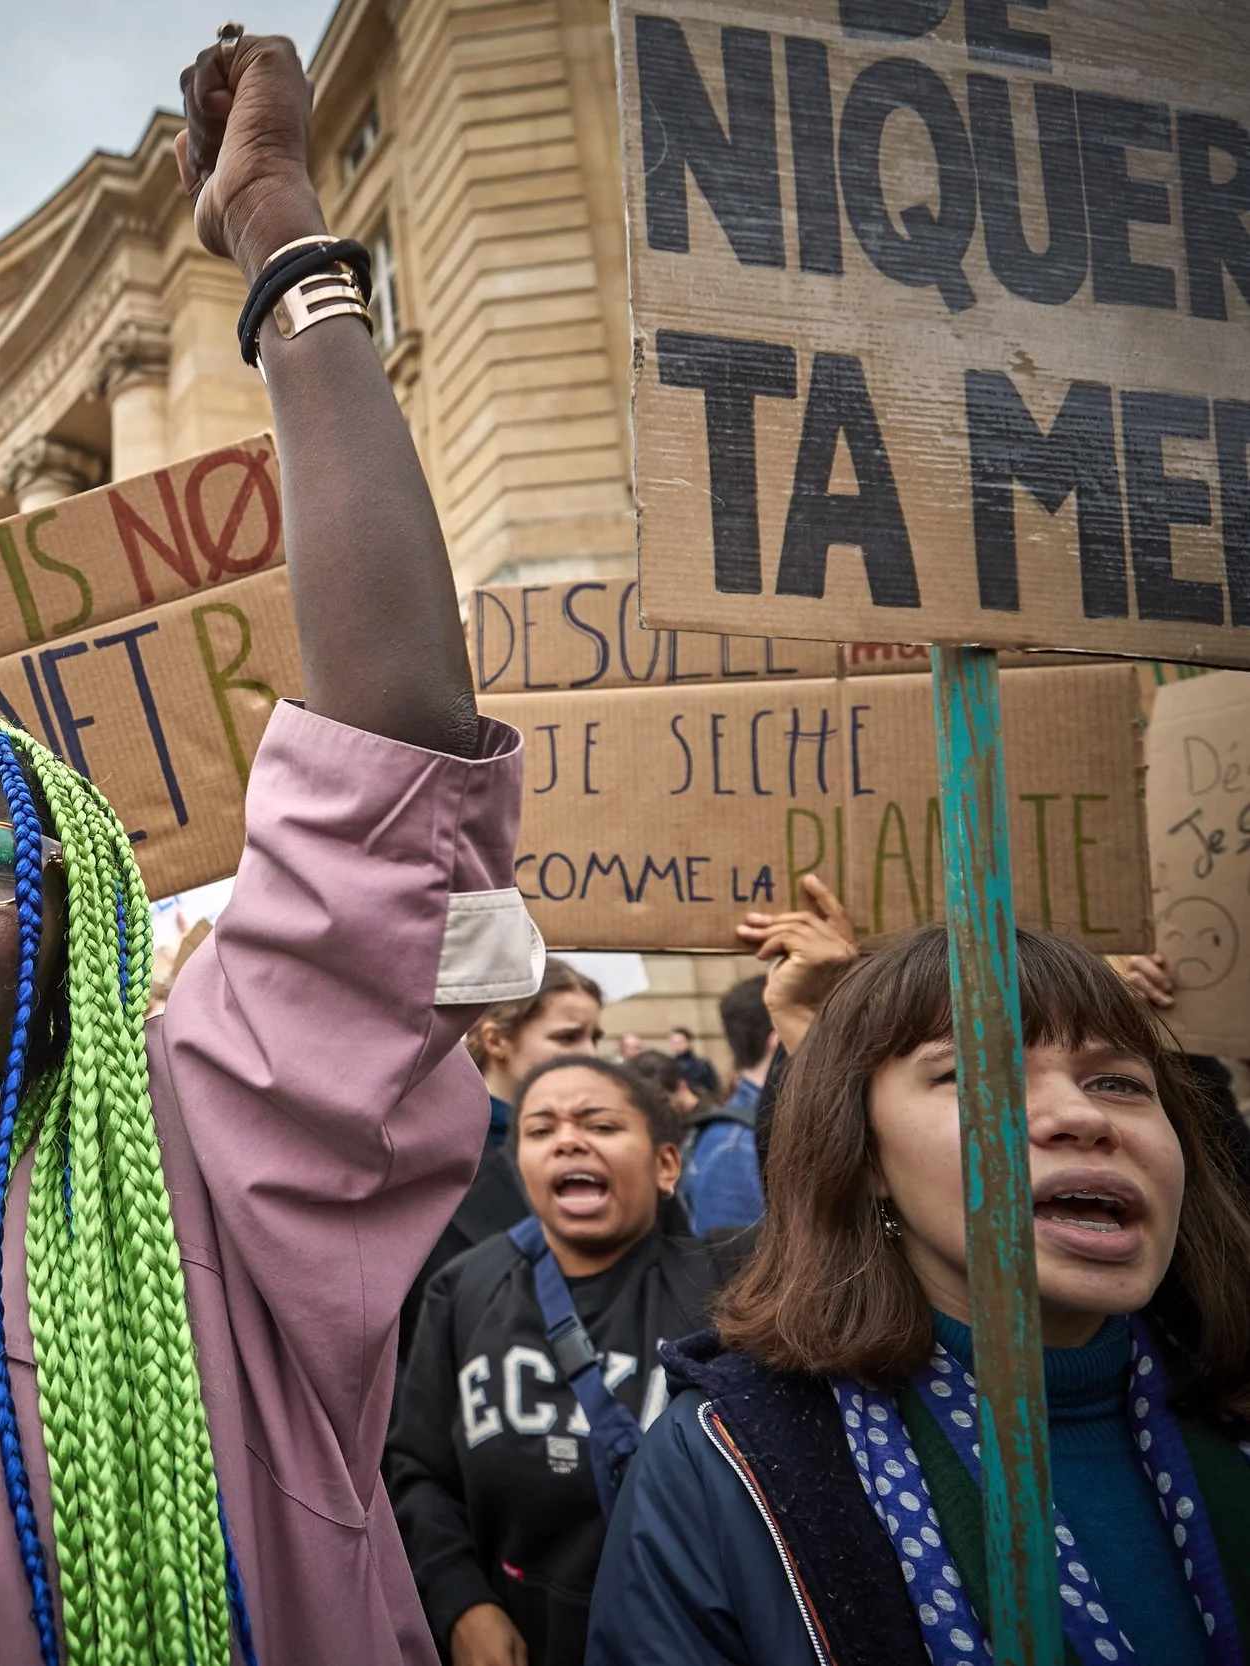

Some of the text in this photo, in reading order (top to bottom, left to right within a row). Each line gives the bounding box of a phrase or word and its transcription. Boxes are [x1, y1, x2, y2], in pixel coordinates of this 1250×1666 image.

[635, 15, 1250, 323] NIQUER
[655, 329, 921, 609] TA
[533, 704, 876, 798] JE SECHE
[515, 852, 715, 904] COMME
[732, 865, 776, 903] LA
